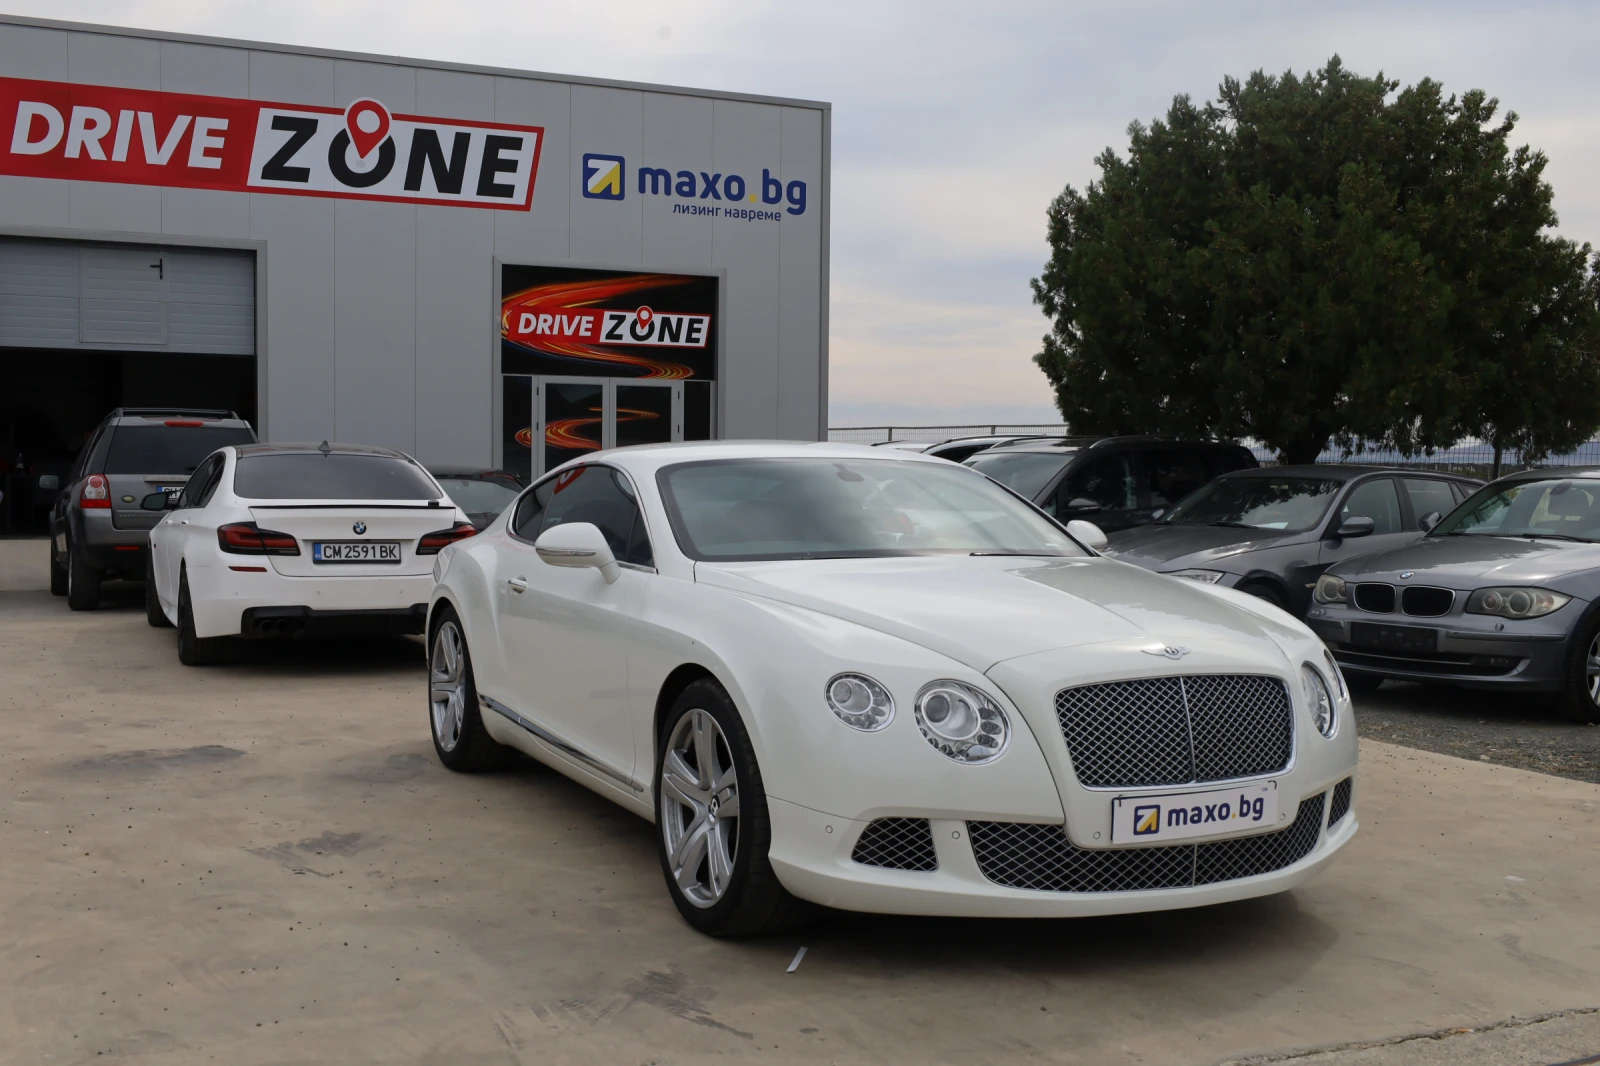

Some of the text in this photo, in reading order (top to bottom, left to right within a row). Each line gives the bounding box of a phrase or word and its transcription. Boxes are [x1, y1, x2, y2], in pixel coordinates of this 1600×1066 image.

[10, 100, 524, 199] DRIVE ZONE
[638, 167, 807, 216] maxo.bg
[672, 203, 782, 222] лизинг навреме
[517, 313, 704, 343] DRIVE ZONE
[323, 545, 397, 559] CM 2591 BK
[1167, 794, 1265, 827] maxo.bg
